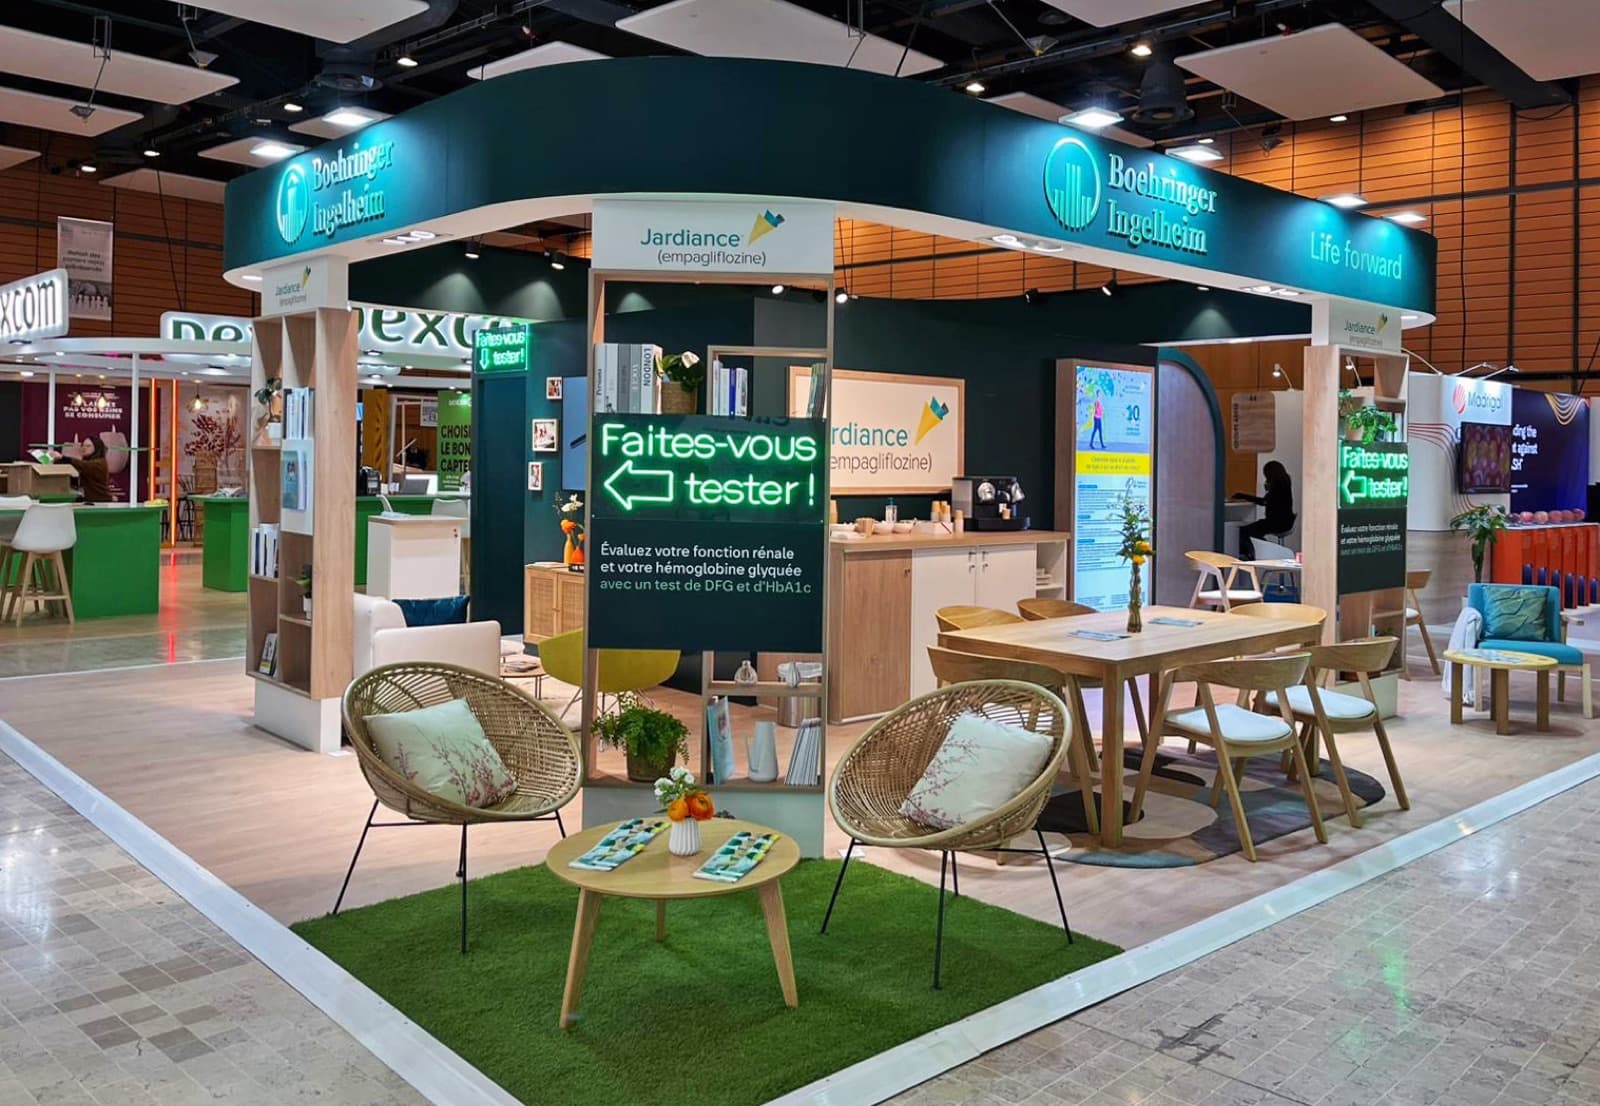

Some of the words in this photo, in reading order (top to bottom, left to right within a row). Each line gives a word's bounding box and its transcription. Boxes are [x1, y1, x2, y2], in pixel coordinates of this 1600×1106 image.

[312, 141, 394, 190] Boehringer
[1108, 153, 1217, 213] Boehringer
[313, 183, 386, 236] Ingelheim
[640, 228, 741, 247] Jardiance
[1106, 199, 1208, 254] Ingelheim
[657, 249, 767, 267] (empagliflozine)
[1310, 231, 1340, 265] Life
[1344, 239, 1403, 281] forward
[0, 279, 56, 336] xcom
[171, 319, 253, 342] De
[475, 331, 525, 348] Faites-vous
[643, 347, 653, 387] LONDON
[602, 422, 817, 462] Faites-vous
[830, 421, 908, 448] rdiance
[441, 442, 450, 455] LE
[1342, 446, 1409, 469] Faites-vous
[829, 453, 933, 475] empagliflozine)
[684, 472, 800, 506] tester
[600, 541, 652, 557] Évaluez
[654, 546, 690, 558] votre
[693, 544, 750, 559] fonction
[752, 545, 795, 560] rénale
[600, 563, 615, 574] et
[617, 564, 653, 575] votre
[655, 561, 745, 578] hémoglobine
[747, 562, 802, 580] glyquée
[600, 580, 632, 590] avec
[634, 581, 652, 591] un
[654, 580, 681, 591] test
[684, 580, 702, 592] de
[704, 580, 734, 592] DFG
[736, 581, 751, 593] et
[753, 580, 812, 594] d'HbA1c
